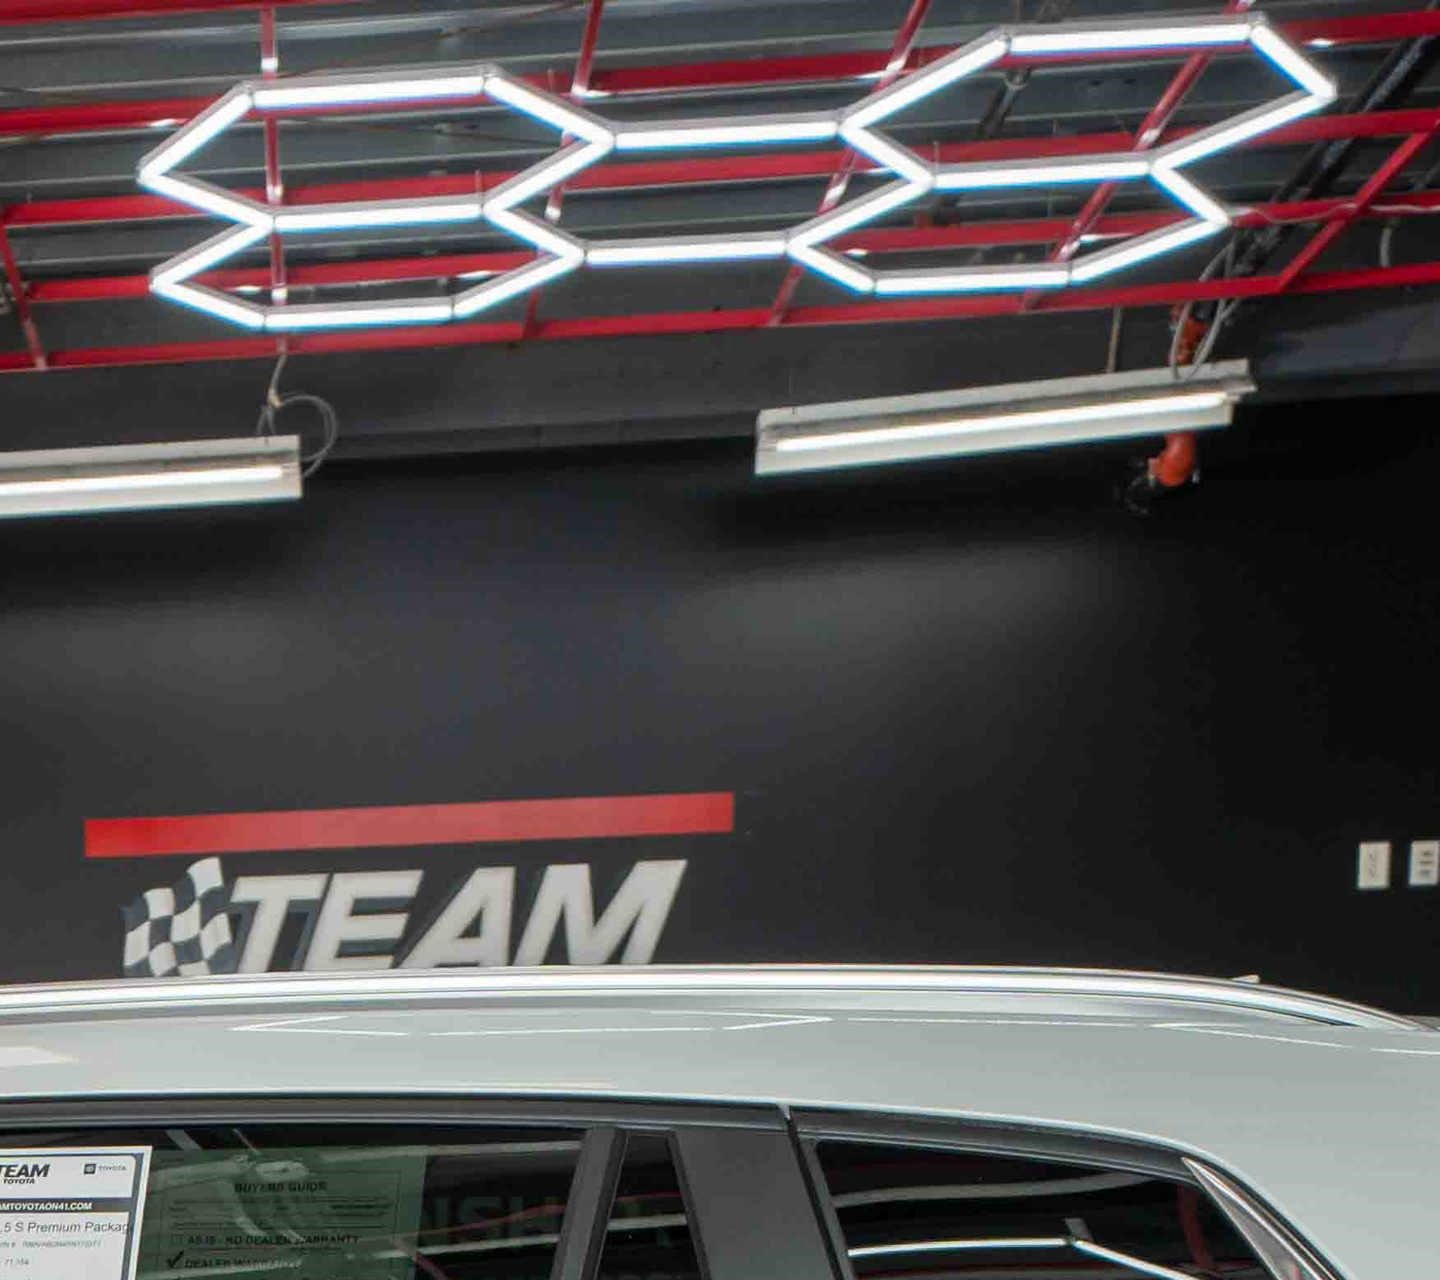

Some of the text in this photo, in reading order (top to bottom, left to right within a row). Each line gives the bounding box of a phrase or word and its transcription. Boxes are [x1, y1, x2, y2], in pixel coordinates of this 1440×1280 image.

[225, 858, 689, 974] TEAM
[14, 1222, 24, 1233] S
[27, 1221, 81, 1233] Premium
